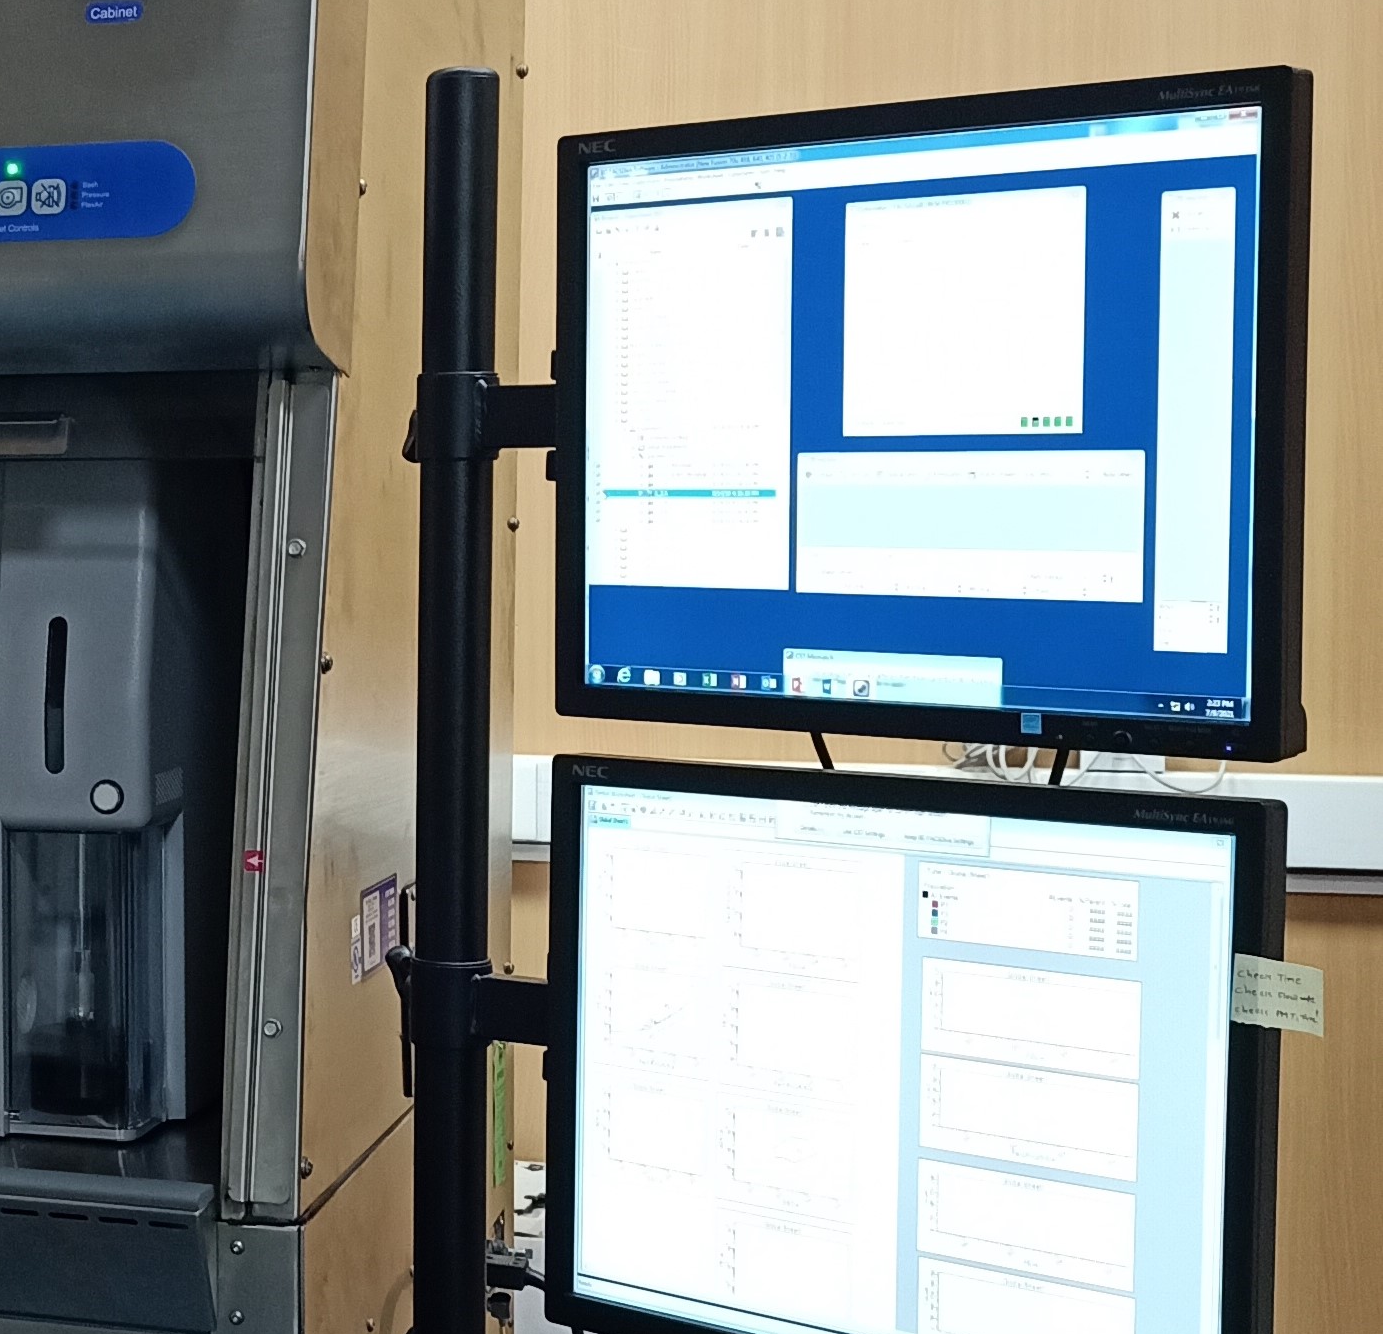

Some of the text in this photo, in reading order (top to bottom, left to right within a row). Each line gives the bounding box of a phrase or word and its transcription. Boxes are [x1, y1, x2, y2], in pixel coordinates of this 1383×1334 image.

[90, 5, 138, 20] Cabinet
[578, 139, 617, 154] NEC
[8, 222, 39, 232] Controls
[572, 764, 610, 779] NEC
